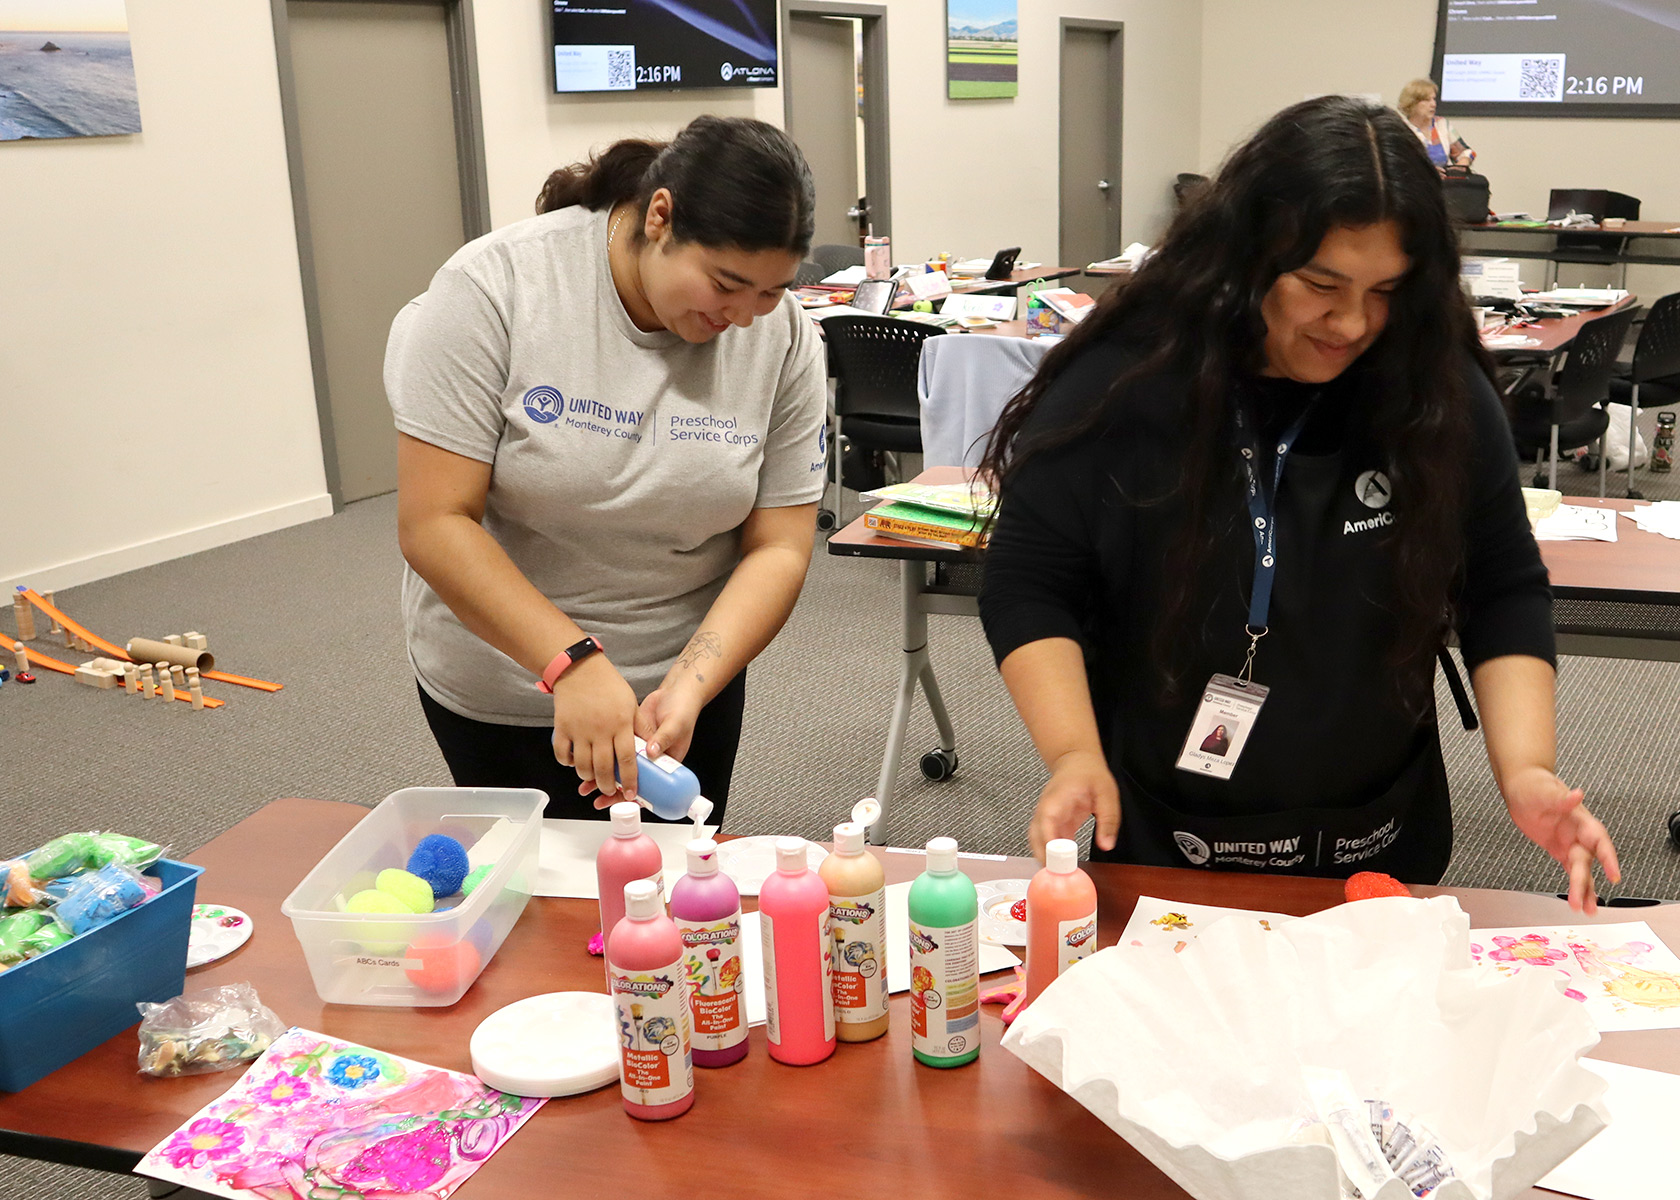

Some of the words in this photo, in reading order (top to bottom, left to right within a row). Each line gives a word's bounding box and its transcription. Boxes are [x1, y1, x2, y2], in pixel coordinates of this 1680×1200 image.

[636, 66, 661, 83] 2:16
[663, 65, 681, 83] PM
[733, 67, 775, 75] ATLONA
[1566, 76, 1608, 95] 2:16
[1612, 76, 1644, 95] PM
[568, 397, 612, 421] UNITED
[615, 410, 644, 427] WAY
[671, 415, 738, 430] Preschool
[565, 417, 613, 438] Monterey
[614, 427, 642, 444] County
[670, 428, 721, 443] Service
[724, 430, 759, 448] Corps
[1343, 511, 1395, 535] AmeriC
[1335, 817, 1395, 851] Preschool
[1214, 841, 1267, 855] UNITED
[1269, 836, 1301, 855] WAY
[1215, 855, 1268, 868] Monterey
[1269, 853, 1306, 868] County
[1333, 844, 1381, 865] Service
[830, 907, 868, 919] RATIONS
[356, 958, 377, 966] ABCs
[378, 959, 400, 967] Cards
[694, 994, 736, 1007] Fluorescent
[699, 1005, 732, 1015] BioColor
[701, 1016, 734, 1026] All-In-One
[626, 1052, 659, 1061] Metallic
[626, 1059, 660, 1070] BioColor
[628, 1072, 661, 1081] All-In-One
